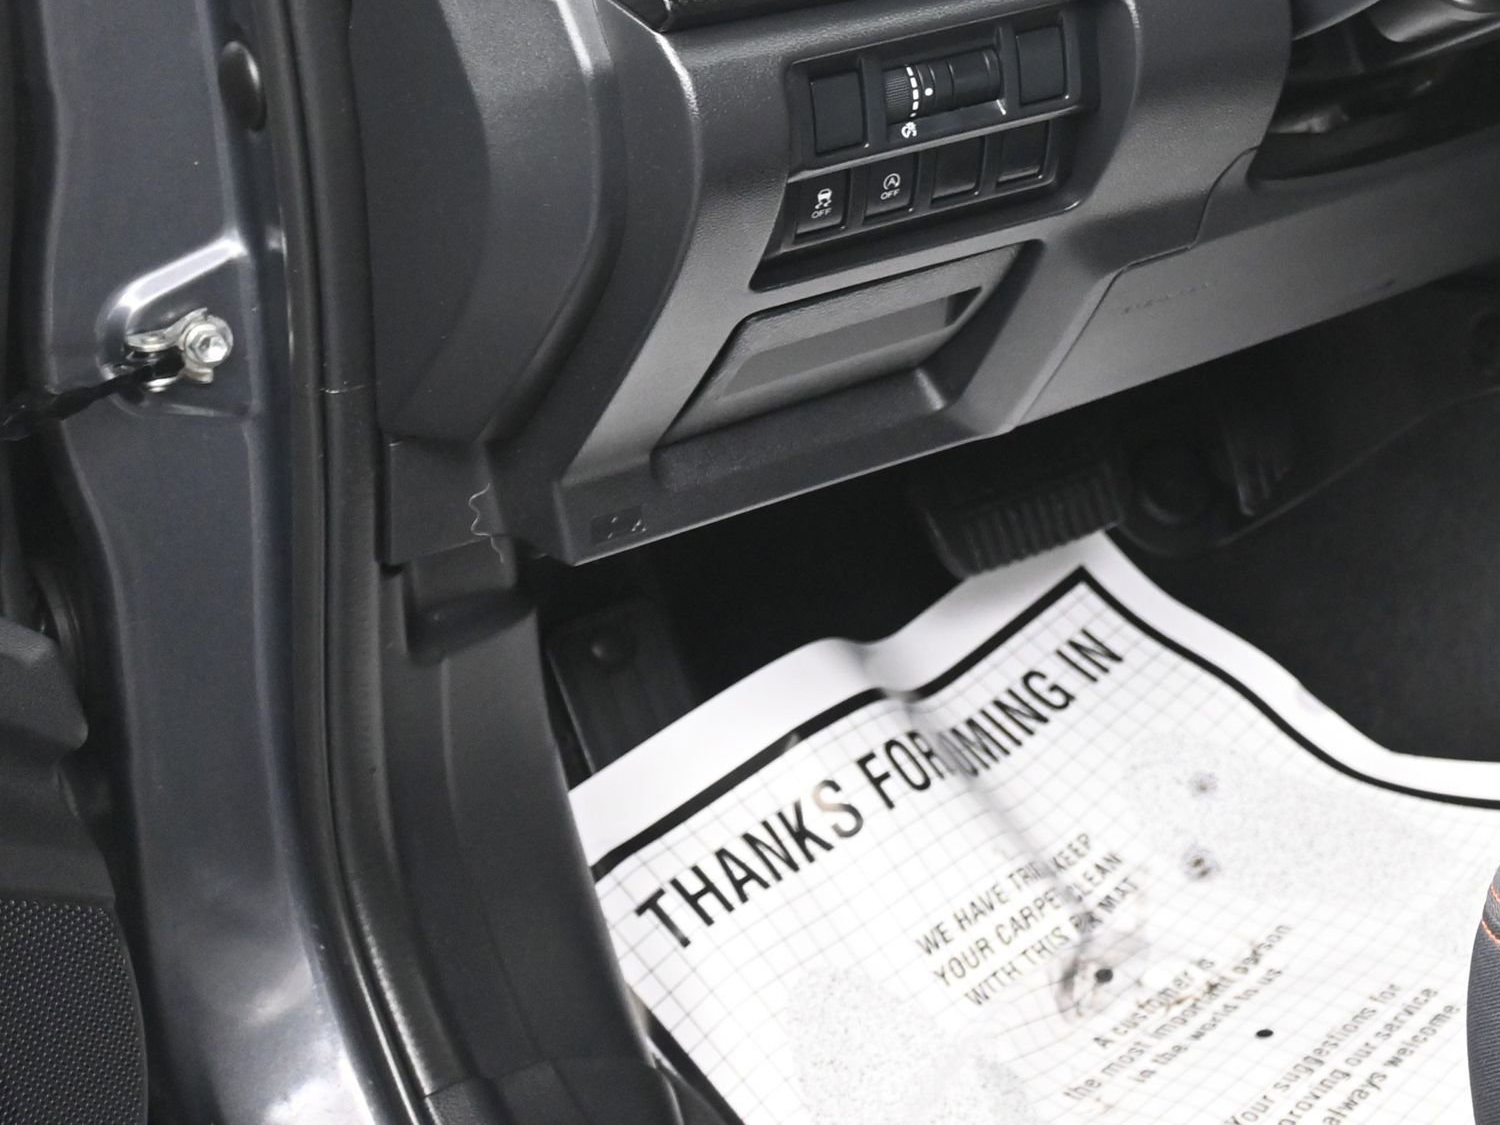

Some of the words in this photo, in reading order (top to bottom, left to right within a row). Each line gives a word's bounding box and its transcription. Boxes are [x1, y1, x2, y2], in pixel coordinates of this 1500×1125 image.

[811, 206, 832, 219] OFF
[880, 188, 900, 201] OFF
[635, 779, 864, 948] THANKS
[856, 730, 953, 810] FOR
[1055, 628, 1123, 682] IN
[916, 921, 954, 955] WE
[953, 882, 1010, 932] HAVE
[933, 936, 996, 987] YOUR
[995, 885, 1063, 946] CARPE
[963, 962, 1023, 1006] WITH
[1021, 925, 1070, 966] THIS
[1097, 876, 1139, 914] MAT
[1063, 1077, 1103, 1101] the
[1101, 1040, 1152, 1077] most
[1149, 976, 1235, 1041] important
[1232, 924, 1293, 976] person
[1093, 1035, 1114, 1049] A
[1111, 970, 1196, 1037] customer
[1152, 1042, 1190, 1066] the
[1190, 1001, 1240, 1041] world
[1234, 986, 1260, 1002] to
[1258, 967, 1284, 987] us
[1273, 1006, 1378, 1091] suggestions
[1369, 982, 1403, 1006] for
[1345, 1041, 1379, 1068] our
[1375, 986, 1439, 1041] service
[1323, 1071, 1388, 1125] always
[1385, 1003, 1461, 1068] welcome
